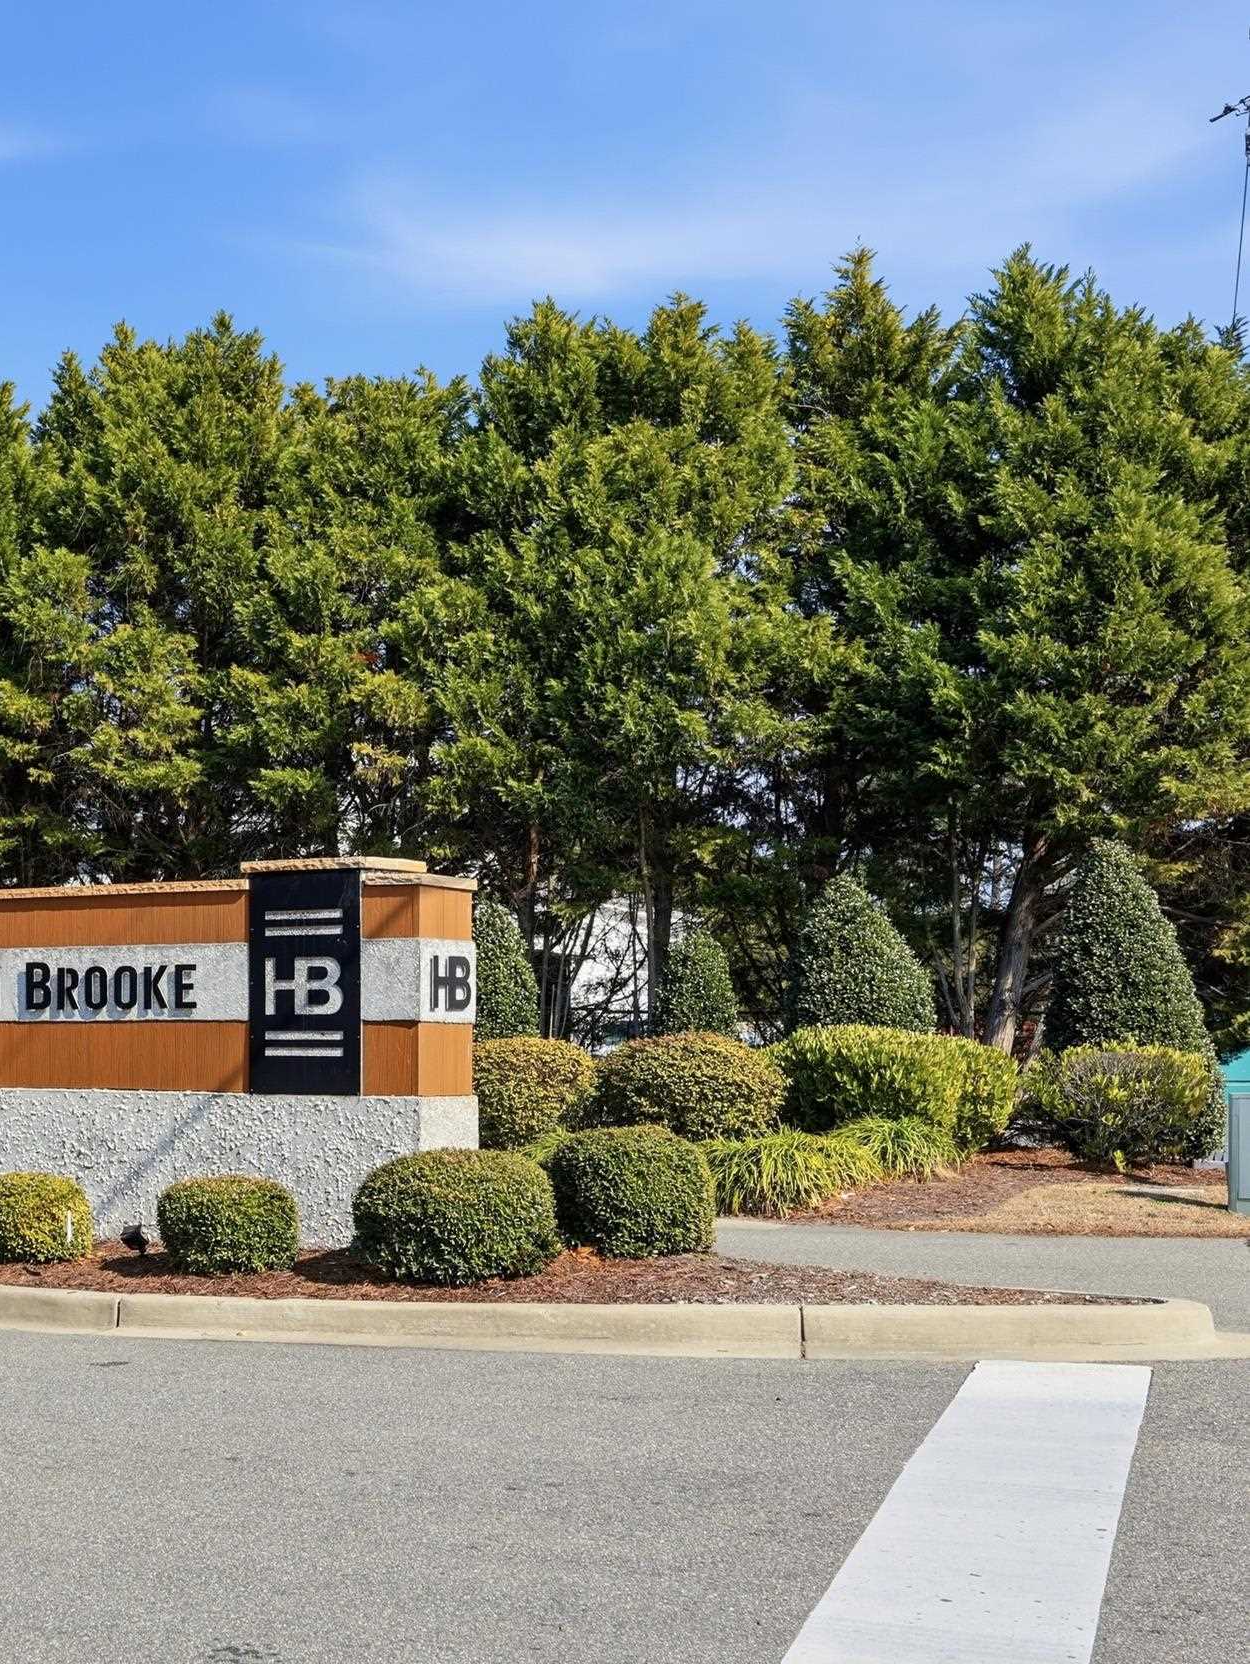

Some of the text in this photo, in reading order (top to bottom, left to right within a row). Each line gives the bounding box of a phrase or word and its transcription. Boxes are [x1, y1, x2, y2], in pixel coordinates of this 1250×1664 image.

[25, 961, 198, 1011] BROOKE
[264, 956, 344, 1016] HB
[429, 955, 472, 1012] HB
